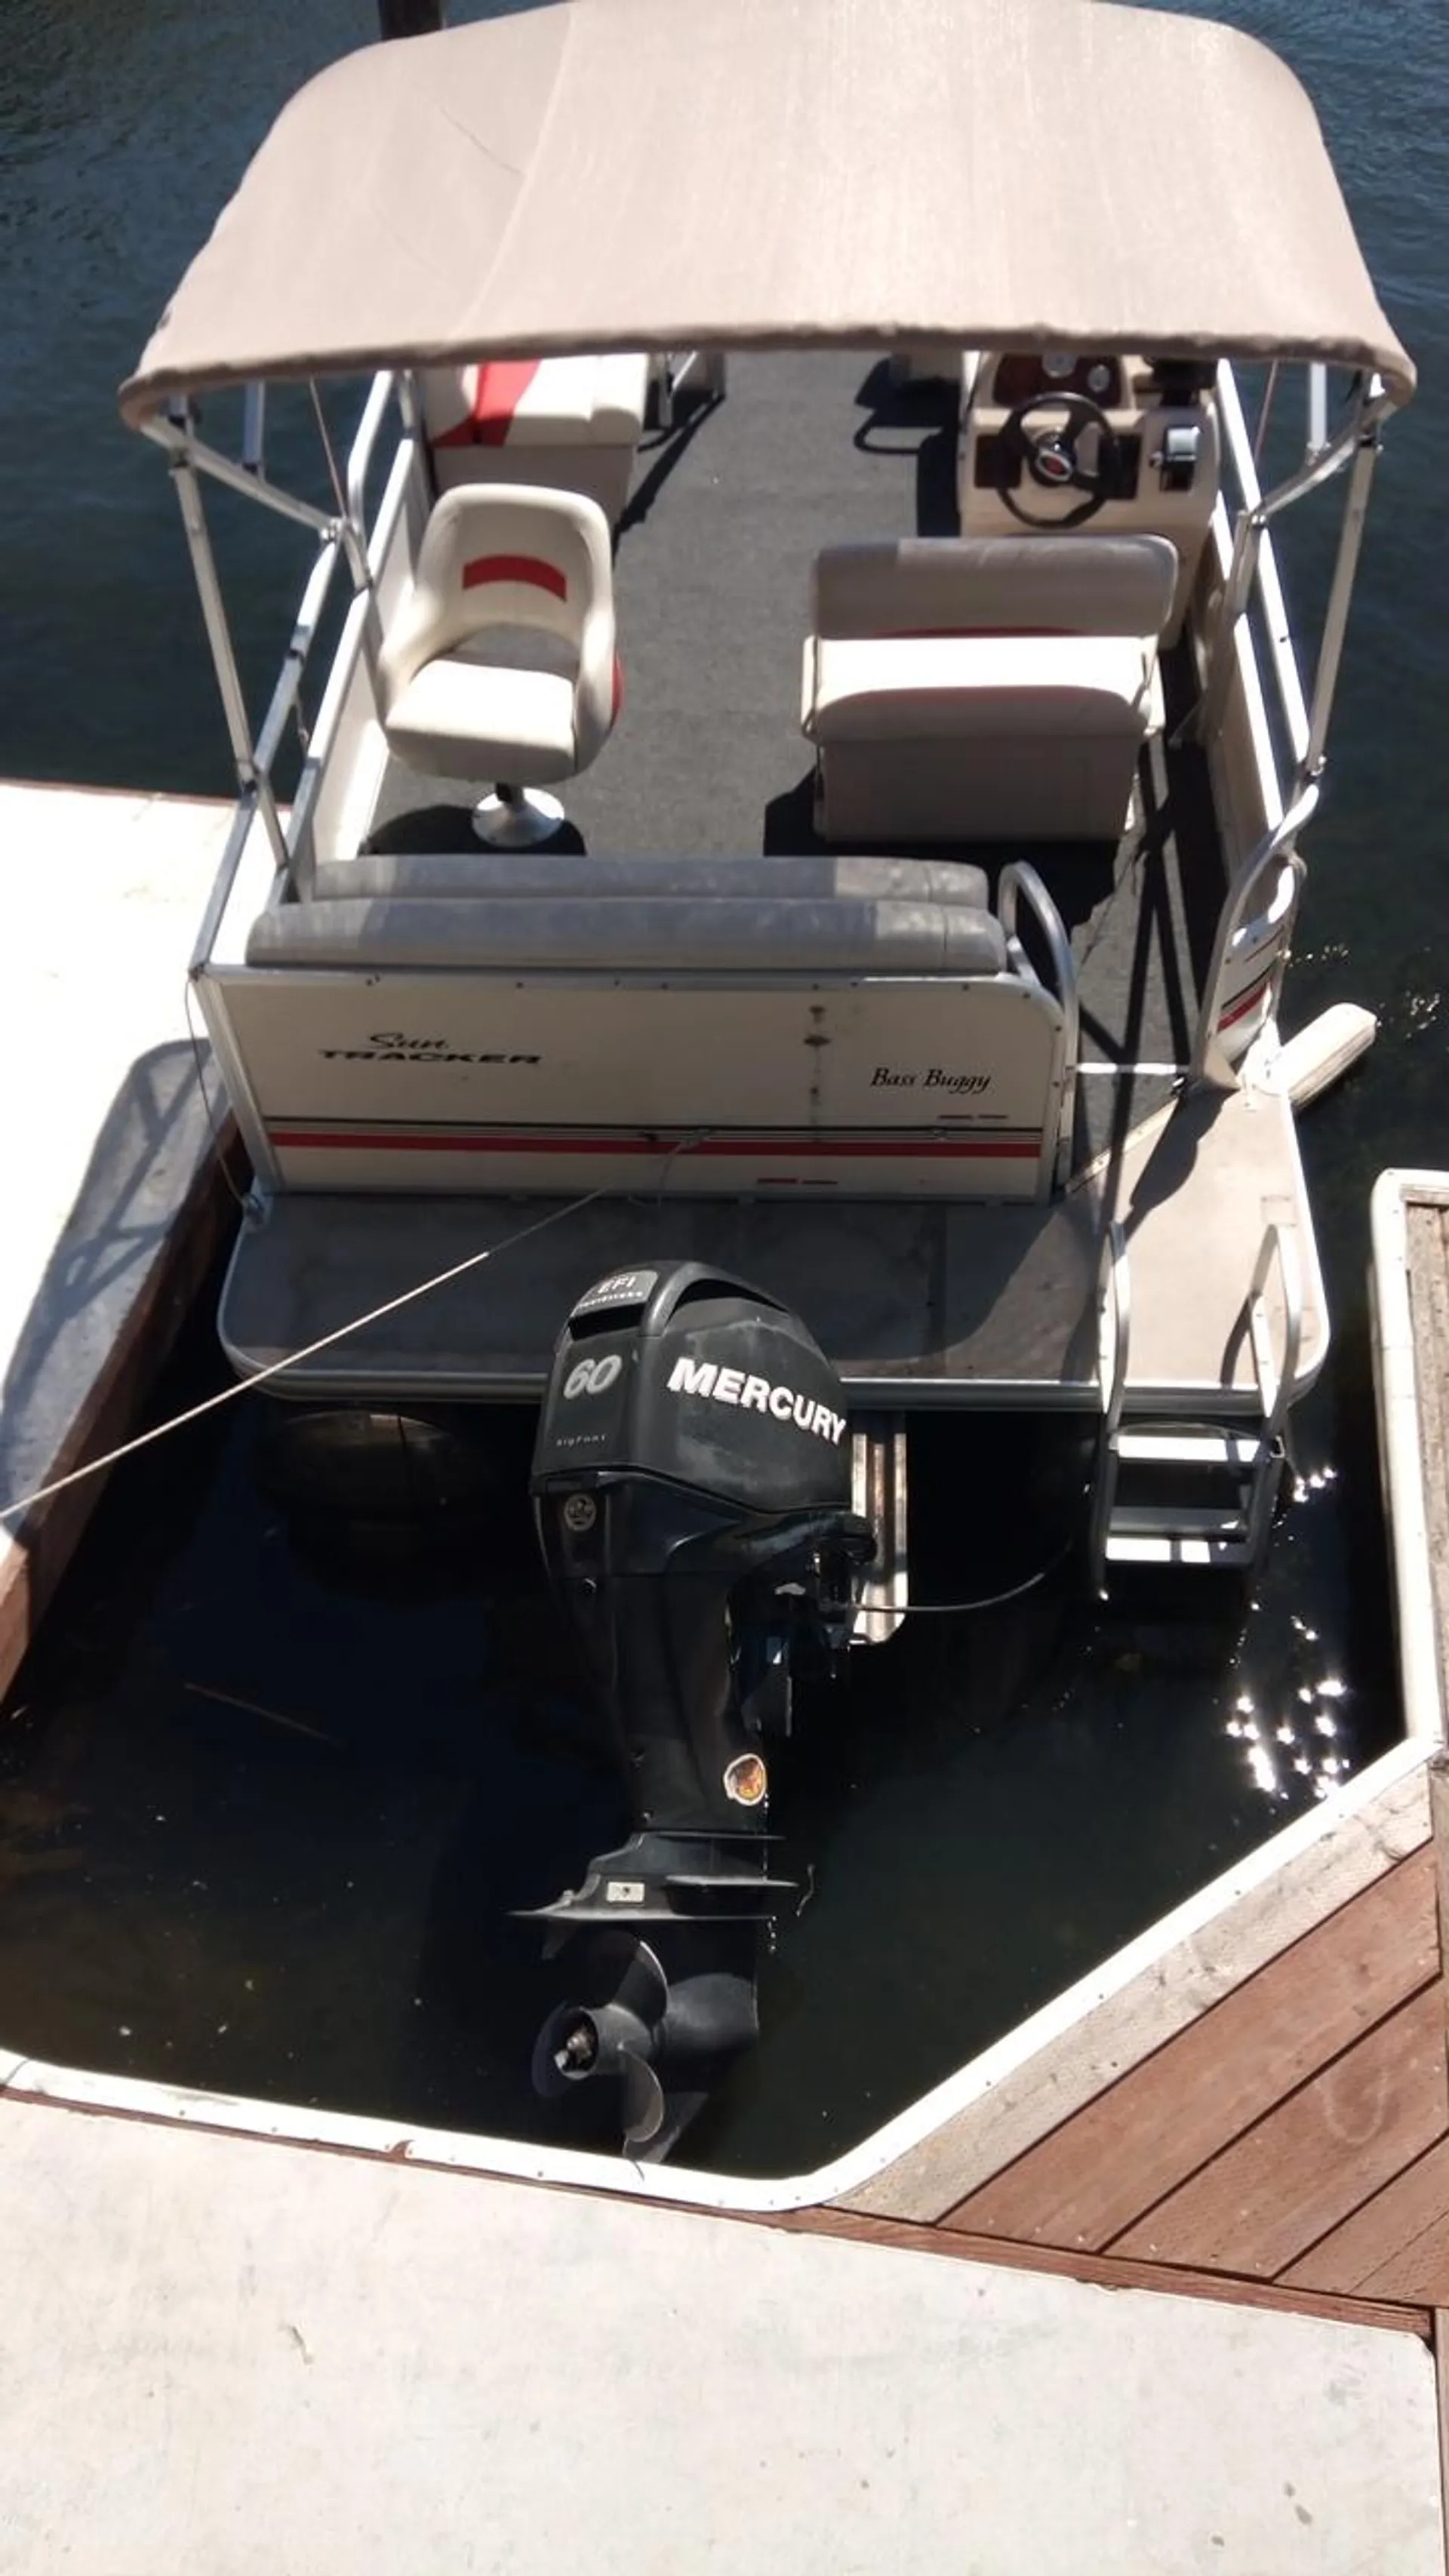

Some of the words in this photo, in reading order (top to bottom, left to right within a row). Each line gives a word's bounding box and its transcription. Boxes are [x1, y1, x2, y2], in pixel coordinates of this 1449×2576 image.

[369, 1032, 448, 1050] Sun
[319, 1049, 542, 1064] TRACKER
[870, 1067, 916, 1088] Bass
[924, 1068, 992, 1094] Buggy
[563, 1354, 623, 1400] 60
[666, 1357, 846, 1445] MERCURY
